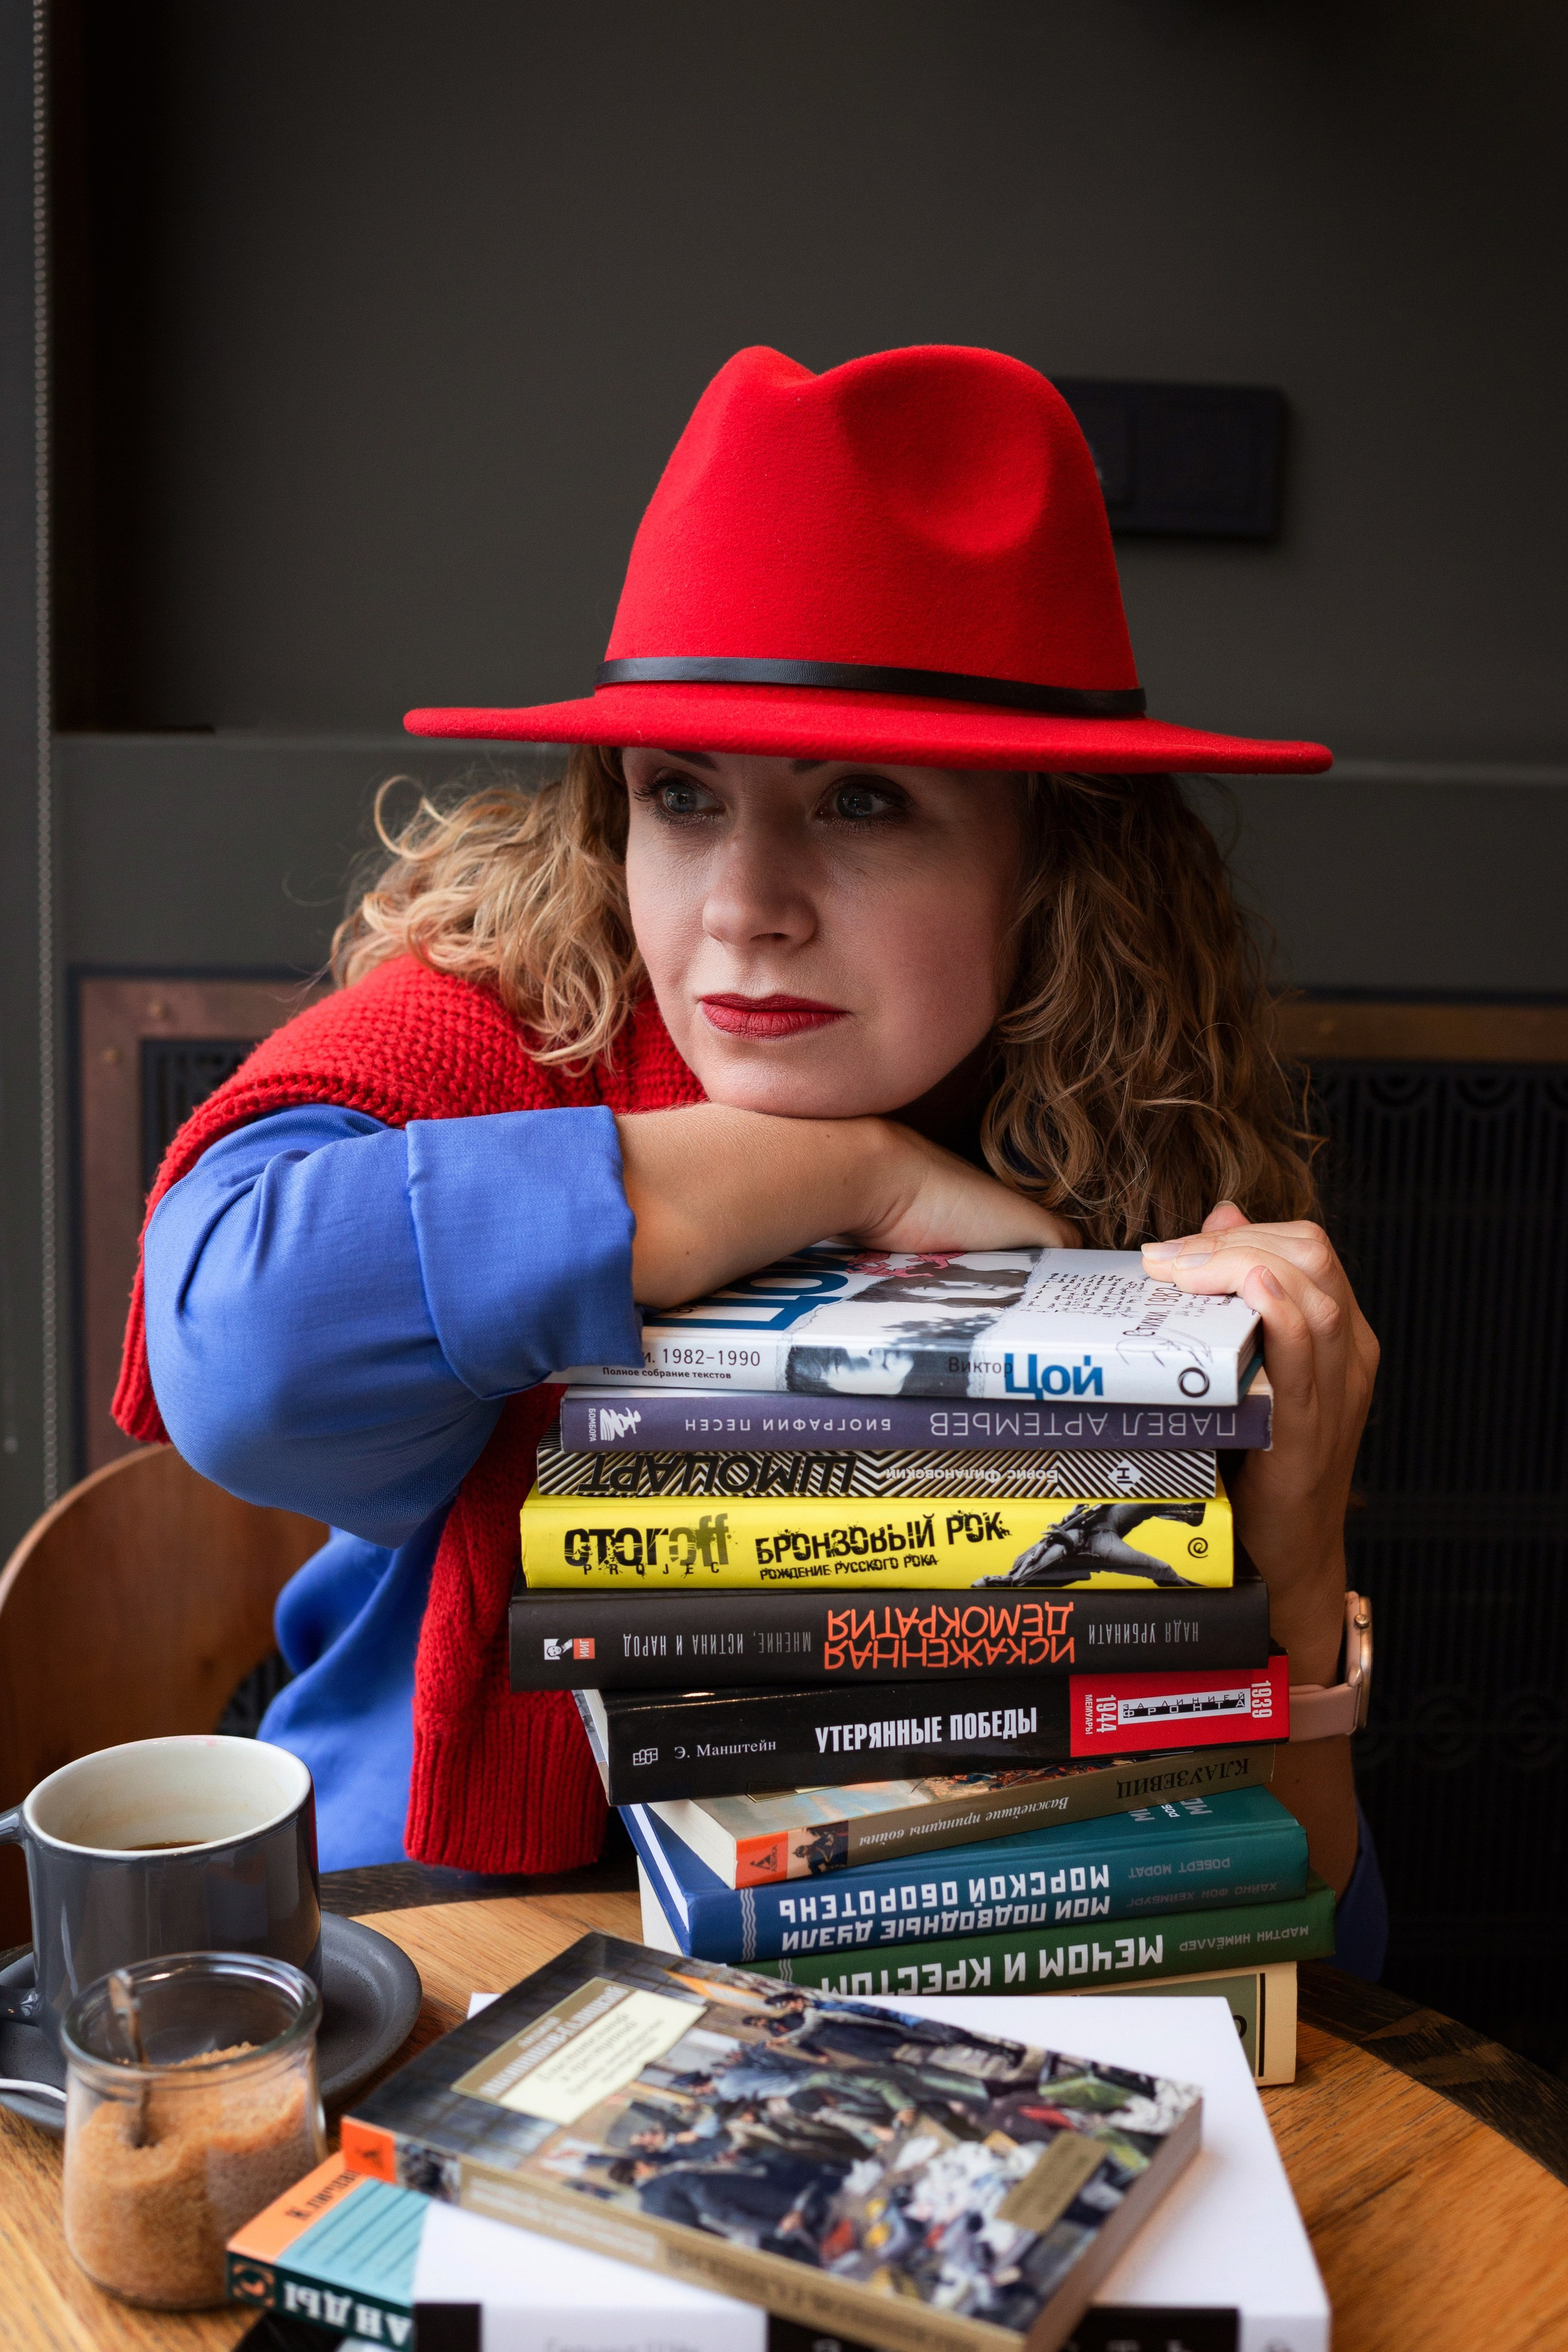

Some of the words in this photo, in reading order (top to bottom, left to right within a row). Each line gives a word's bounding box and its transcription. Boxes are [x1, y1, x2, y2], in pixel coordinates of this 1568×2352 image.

[602, 1366, 640, 1376] Полное
[641, 1368, 690, 1379] собрание
[692, 1371, 732, 1379] текстов
[948, 1356, 1013, 1378] Виктор
[1004, 1352, 1104, 1401] Цой
[588, 1408, 597, 1442] БОМБОРА
[683, 1417, 752, 1432] ПЕСЕН
[761, 1417, 892, 1432] БИОГРАФИИ
[930, 1412, 1107, 1437] АРТЕМЬЕВ
[1123, 1412, 1237, 1437] ПАВЕЛ
[578, 1453, 858, 1494] ШМОЦАРТ
[755, 1513, 935, 1565] БРОНЗОВЫЙ
[946, 1511, 1005, 1546] РОК
[759, 1563, 832, 1581] РОЖДЕНИЕ
[834, 1556, 899, 1575] РУССКОГО
[903, 1553, 939, 1569] РОКА
[827, 1601, 1075, 1643] ДЕМОКРАТИЯ
[1088, 1621, 1156, 1645] УРБИНАТИ
[1164, 1619, 1199, 1643] НАДЯ
[622, 1633, 666, 1657] НАРОД
[676, 1634, 683, 1656] И
[692, 1632, 744, 1655] ИСТИНА
[752, 1630, 812, 1654] МНЕНИЕ,
[823, 1635, 1076, 1670] ИСКАЖЕННАЯ
[1123, 1702, 1145, 1711] ЗА
[1162, 1691, 1245, 1707] ЛИНИЕЙ
[1123, 1698, 1246, 1717] ФРОНТА
[1251, 1679, 1273, 1719] 1939
[1084, 1694, 1093, 1735] МЕМУАРЫ
[1095, 1694, 1117, 1733] 1944
[815, 1716, 942, 1754] УТЕРЯННЫЕ
[949, 1706, 1037, 1740] ПОБЕДЫ
[674, 1746, 690, 1759] Э.
[696, 1738, 777, 1758] Манштейн
[1116, 1757, 1250, 1800] КЛАУЗЕВИЦ
[985, 1796, 1070, 1822] Важнейшие
[859, 1828, 905, 1847] войны
[910, 1814, 982, 1836] принципы
[1128, 1863, 1172, 1879] МОРАТ
[1178, 1857, 1231, 1874] РОБЕРТ
[968, 1864, 1110, 1908] МОРСКОЙ
[1200, 1888, 1229, 1899] ФОН
[778, 1880, 958, 1924] ОБОРОТЕНЬ
[1054, 1895, 1110, 1920] МОИ
[880, 1902, 1047, 1940] ПОДВОДНЫЕ
[781, 1920, 873, 1952] ДУЭЛИ
[1178, 1933, 1251, 1952] НИМЁЛЛЕР
[1257, 1925, 1310, 1943] МАРТИН
[1004, 1951, 1027, 1984] И
[1039, 1934, 1164, 1979] МЕЧОМ
